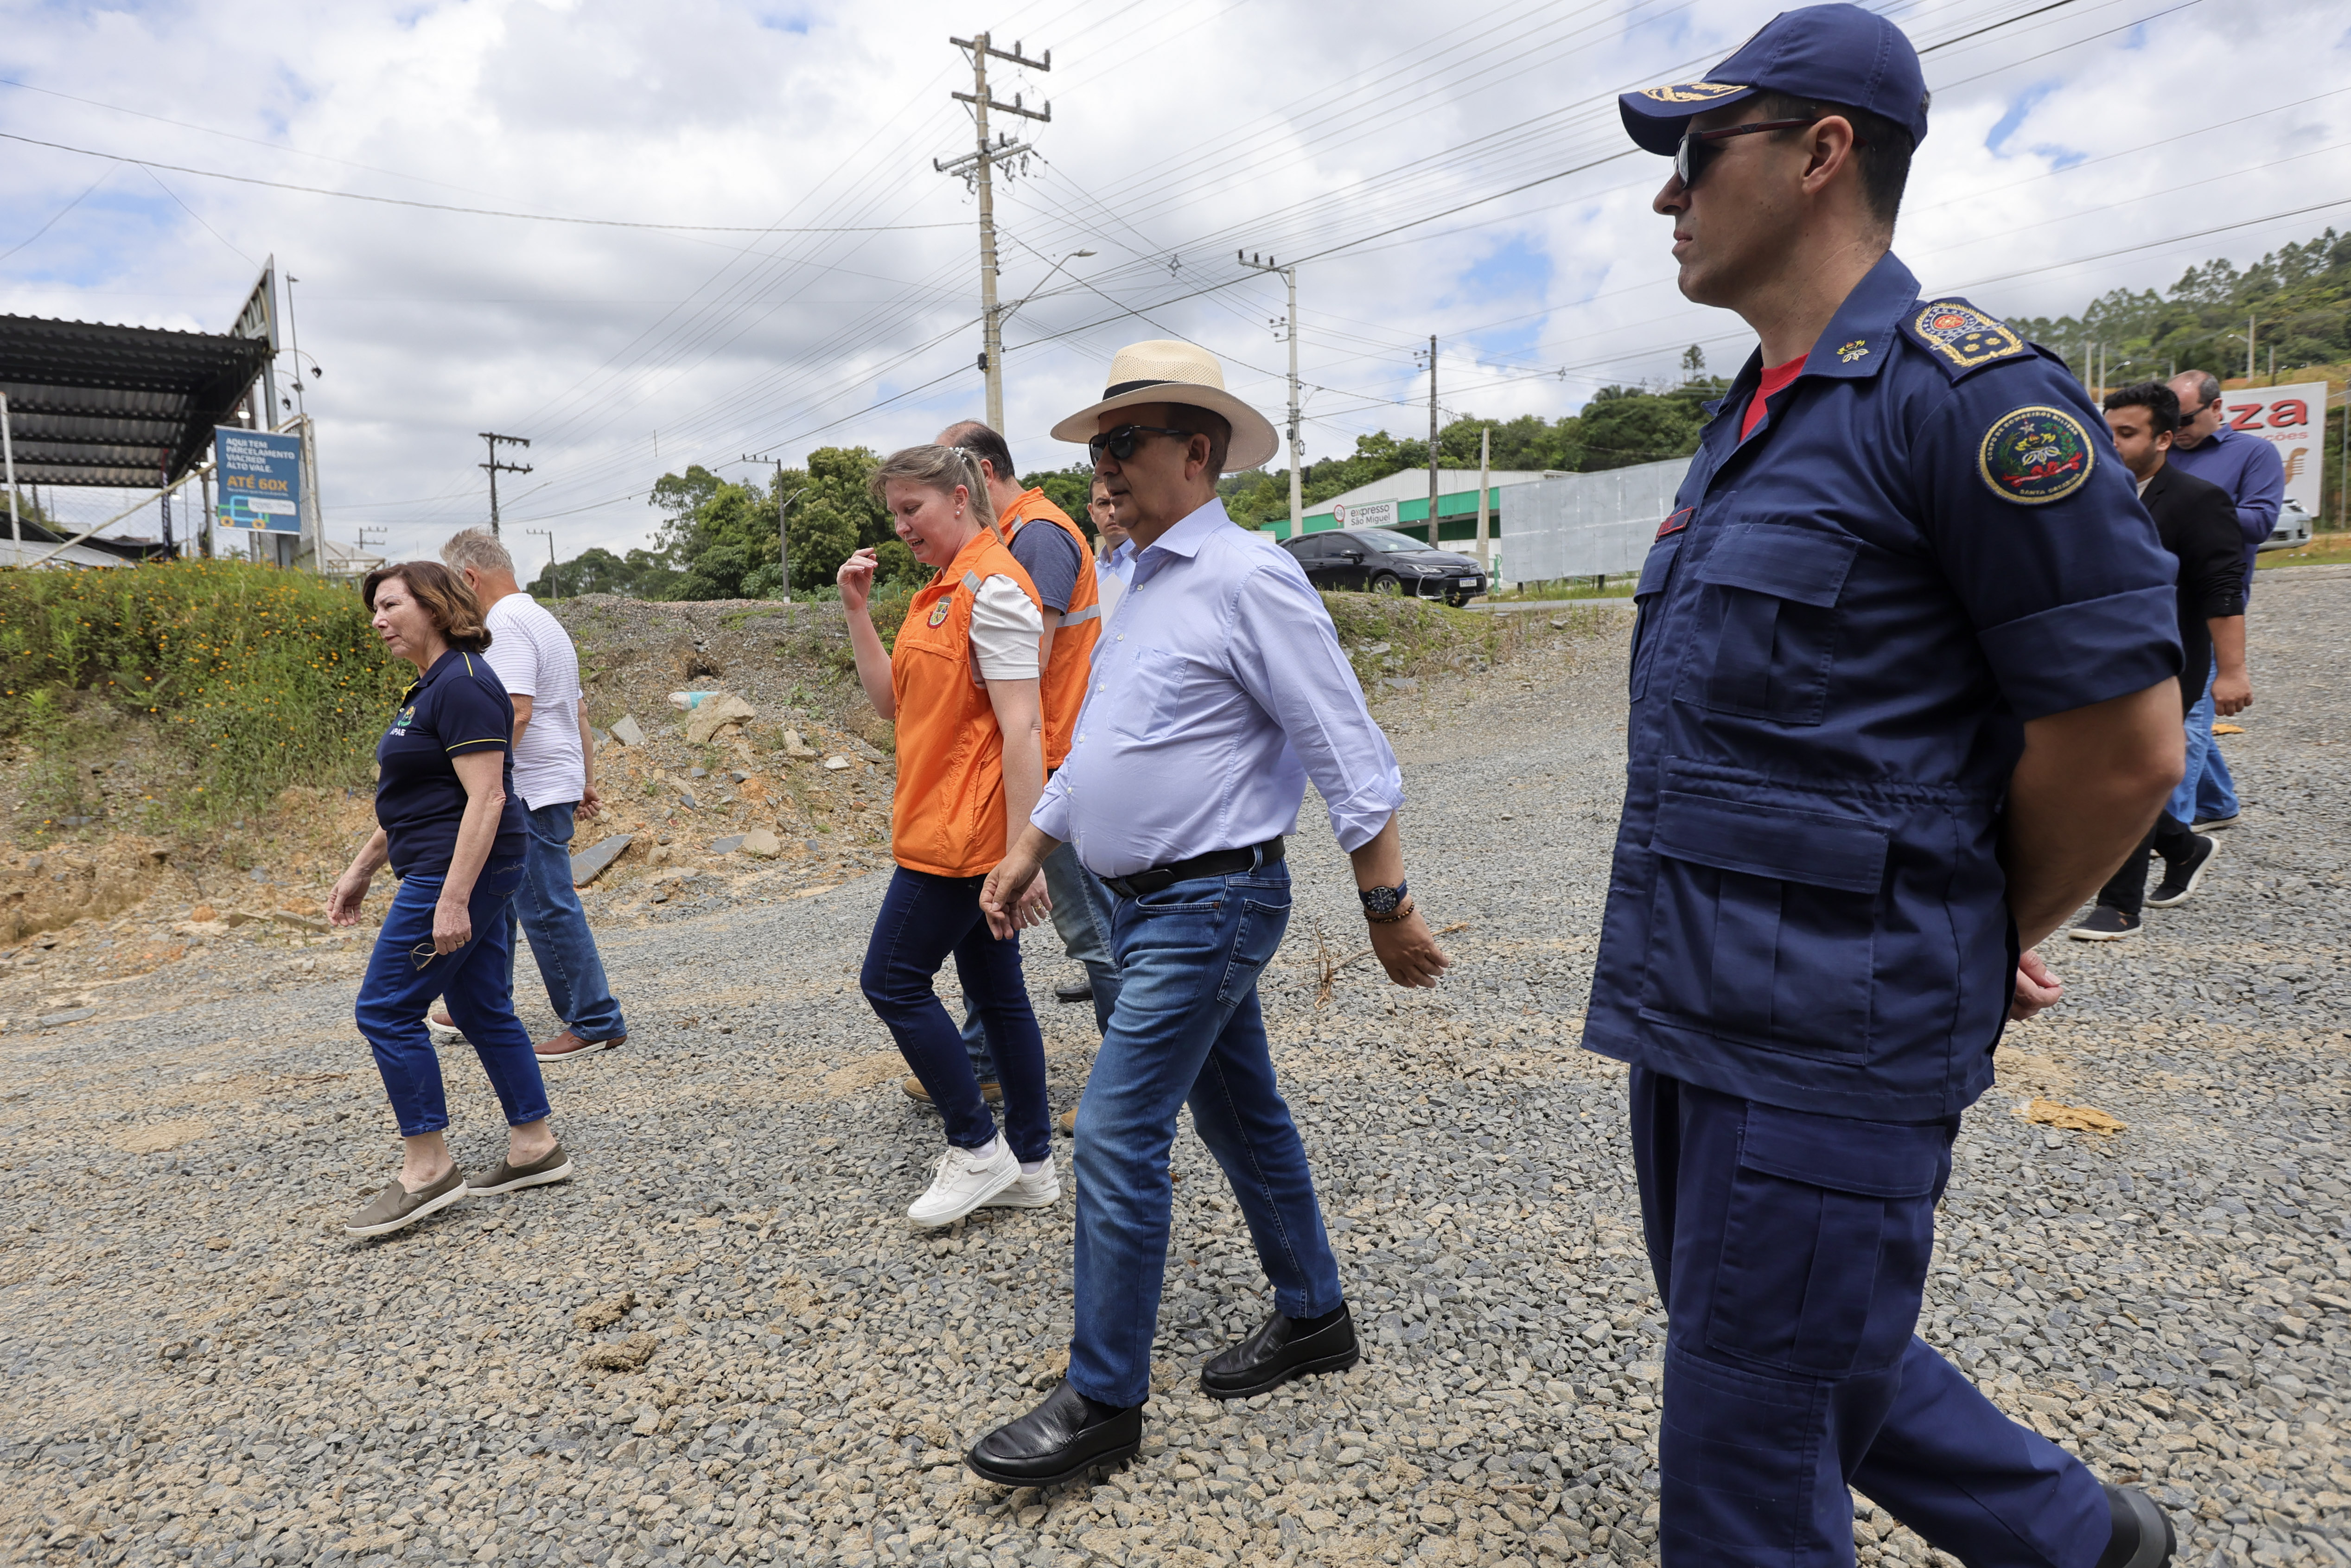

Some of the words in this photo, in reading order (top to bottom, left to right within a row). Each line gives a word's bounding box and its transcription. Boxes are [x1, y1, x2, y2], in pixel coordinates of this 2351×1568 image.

[2219, 399, 2307, 431] za
[1987, 437, 1997, 461] CORPO
[1995, 428, 2005, 437] DE
[2003, 411, 2052, 428] BOMBEIROS
[2052, 414, 2079, 435] MILITAR
[225, 438, 248, 447] AQUI
[248, 440, 268, 449] TEM
[225, 445, 296, 459] PARCELAMENTO
[225, 453, 267, 465] VIACREDI
[226, 461, 249, 471] ALTO
[249, 464, 274, 473] VALE.
[226, 474, 255, 489] ATÉ
[258, 478, 288, 492] 60X
[2048, 473, 2081, 493] CATARINA
[1351, 504, 1390, 518] expresso
[1351, 517, 1364, 526] São
[1366, 513, 1390, 524] Miguel
[389, 728, 406, 736] APAE
